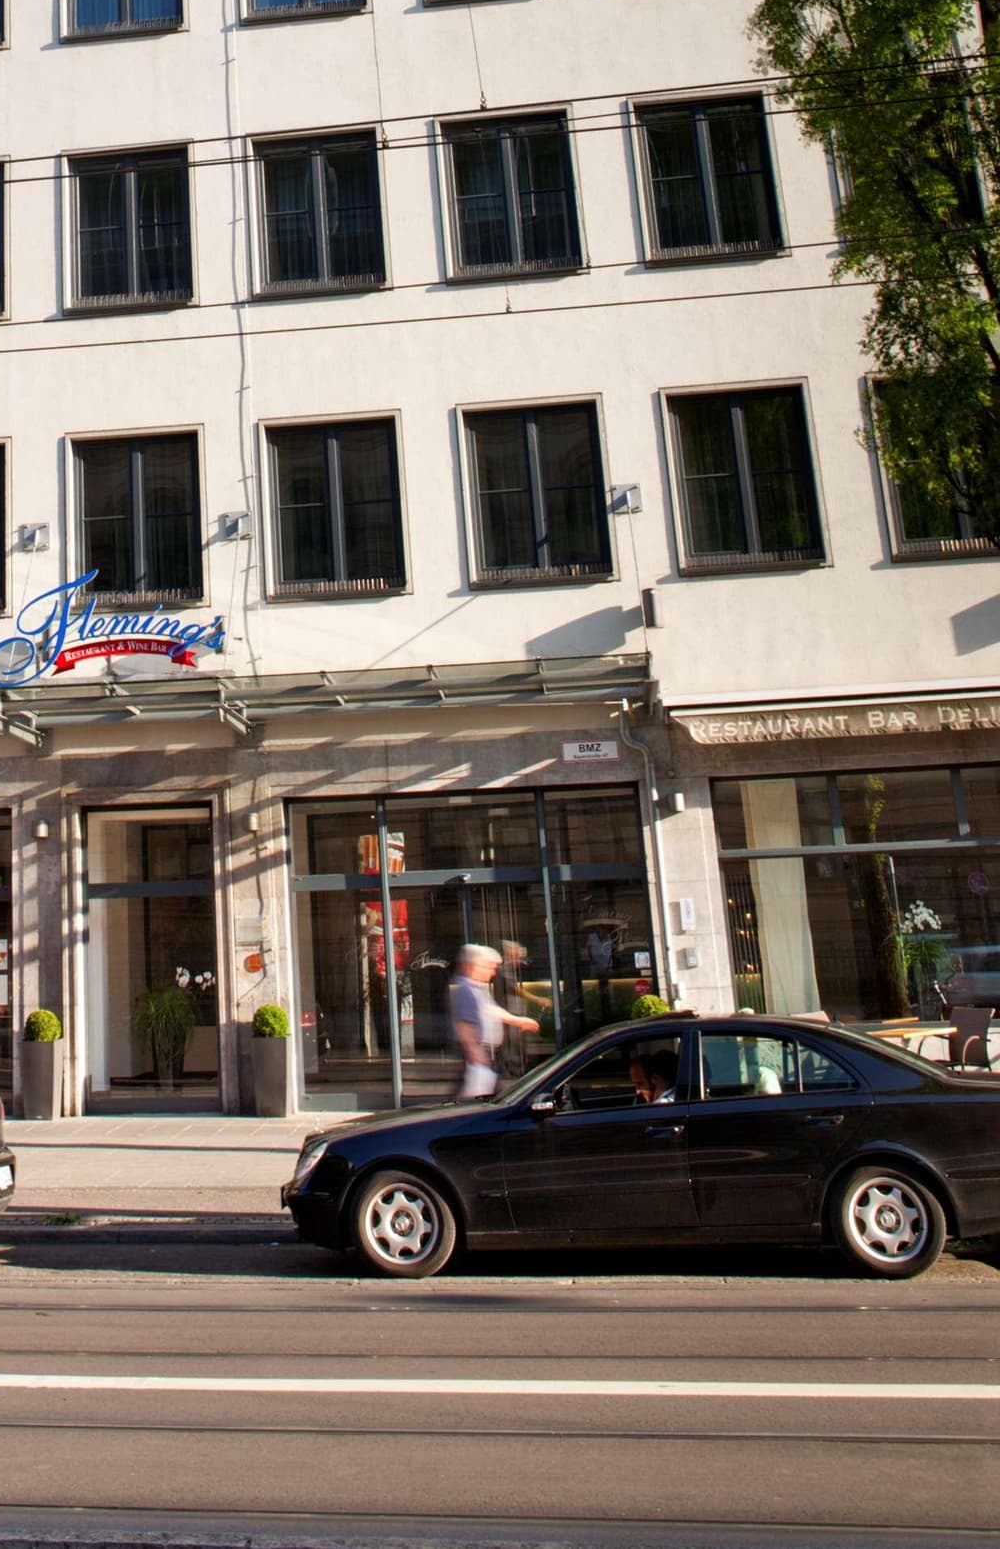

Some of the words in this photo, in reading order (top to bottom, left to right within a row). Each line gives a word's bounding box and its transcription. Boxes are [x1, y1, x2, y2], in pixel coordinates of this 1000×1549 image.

[117, 642, 125, 651] &
[151, 641, 168, 652] BAR
[690, 714, 849, 739] RESTAURANT
[867, 710, 918, 728] BAR
[579, 743, 602, 753] BMZ
